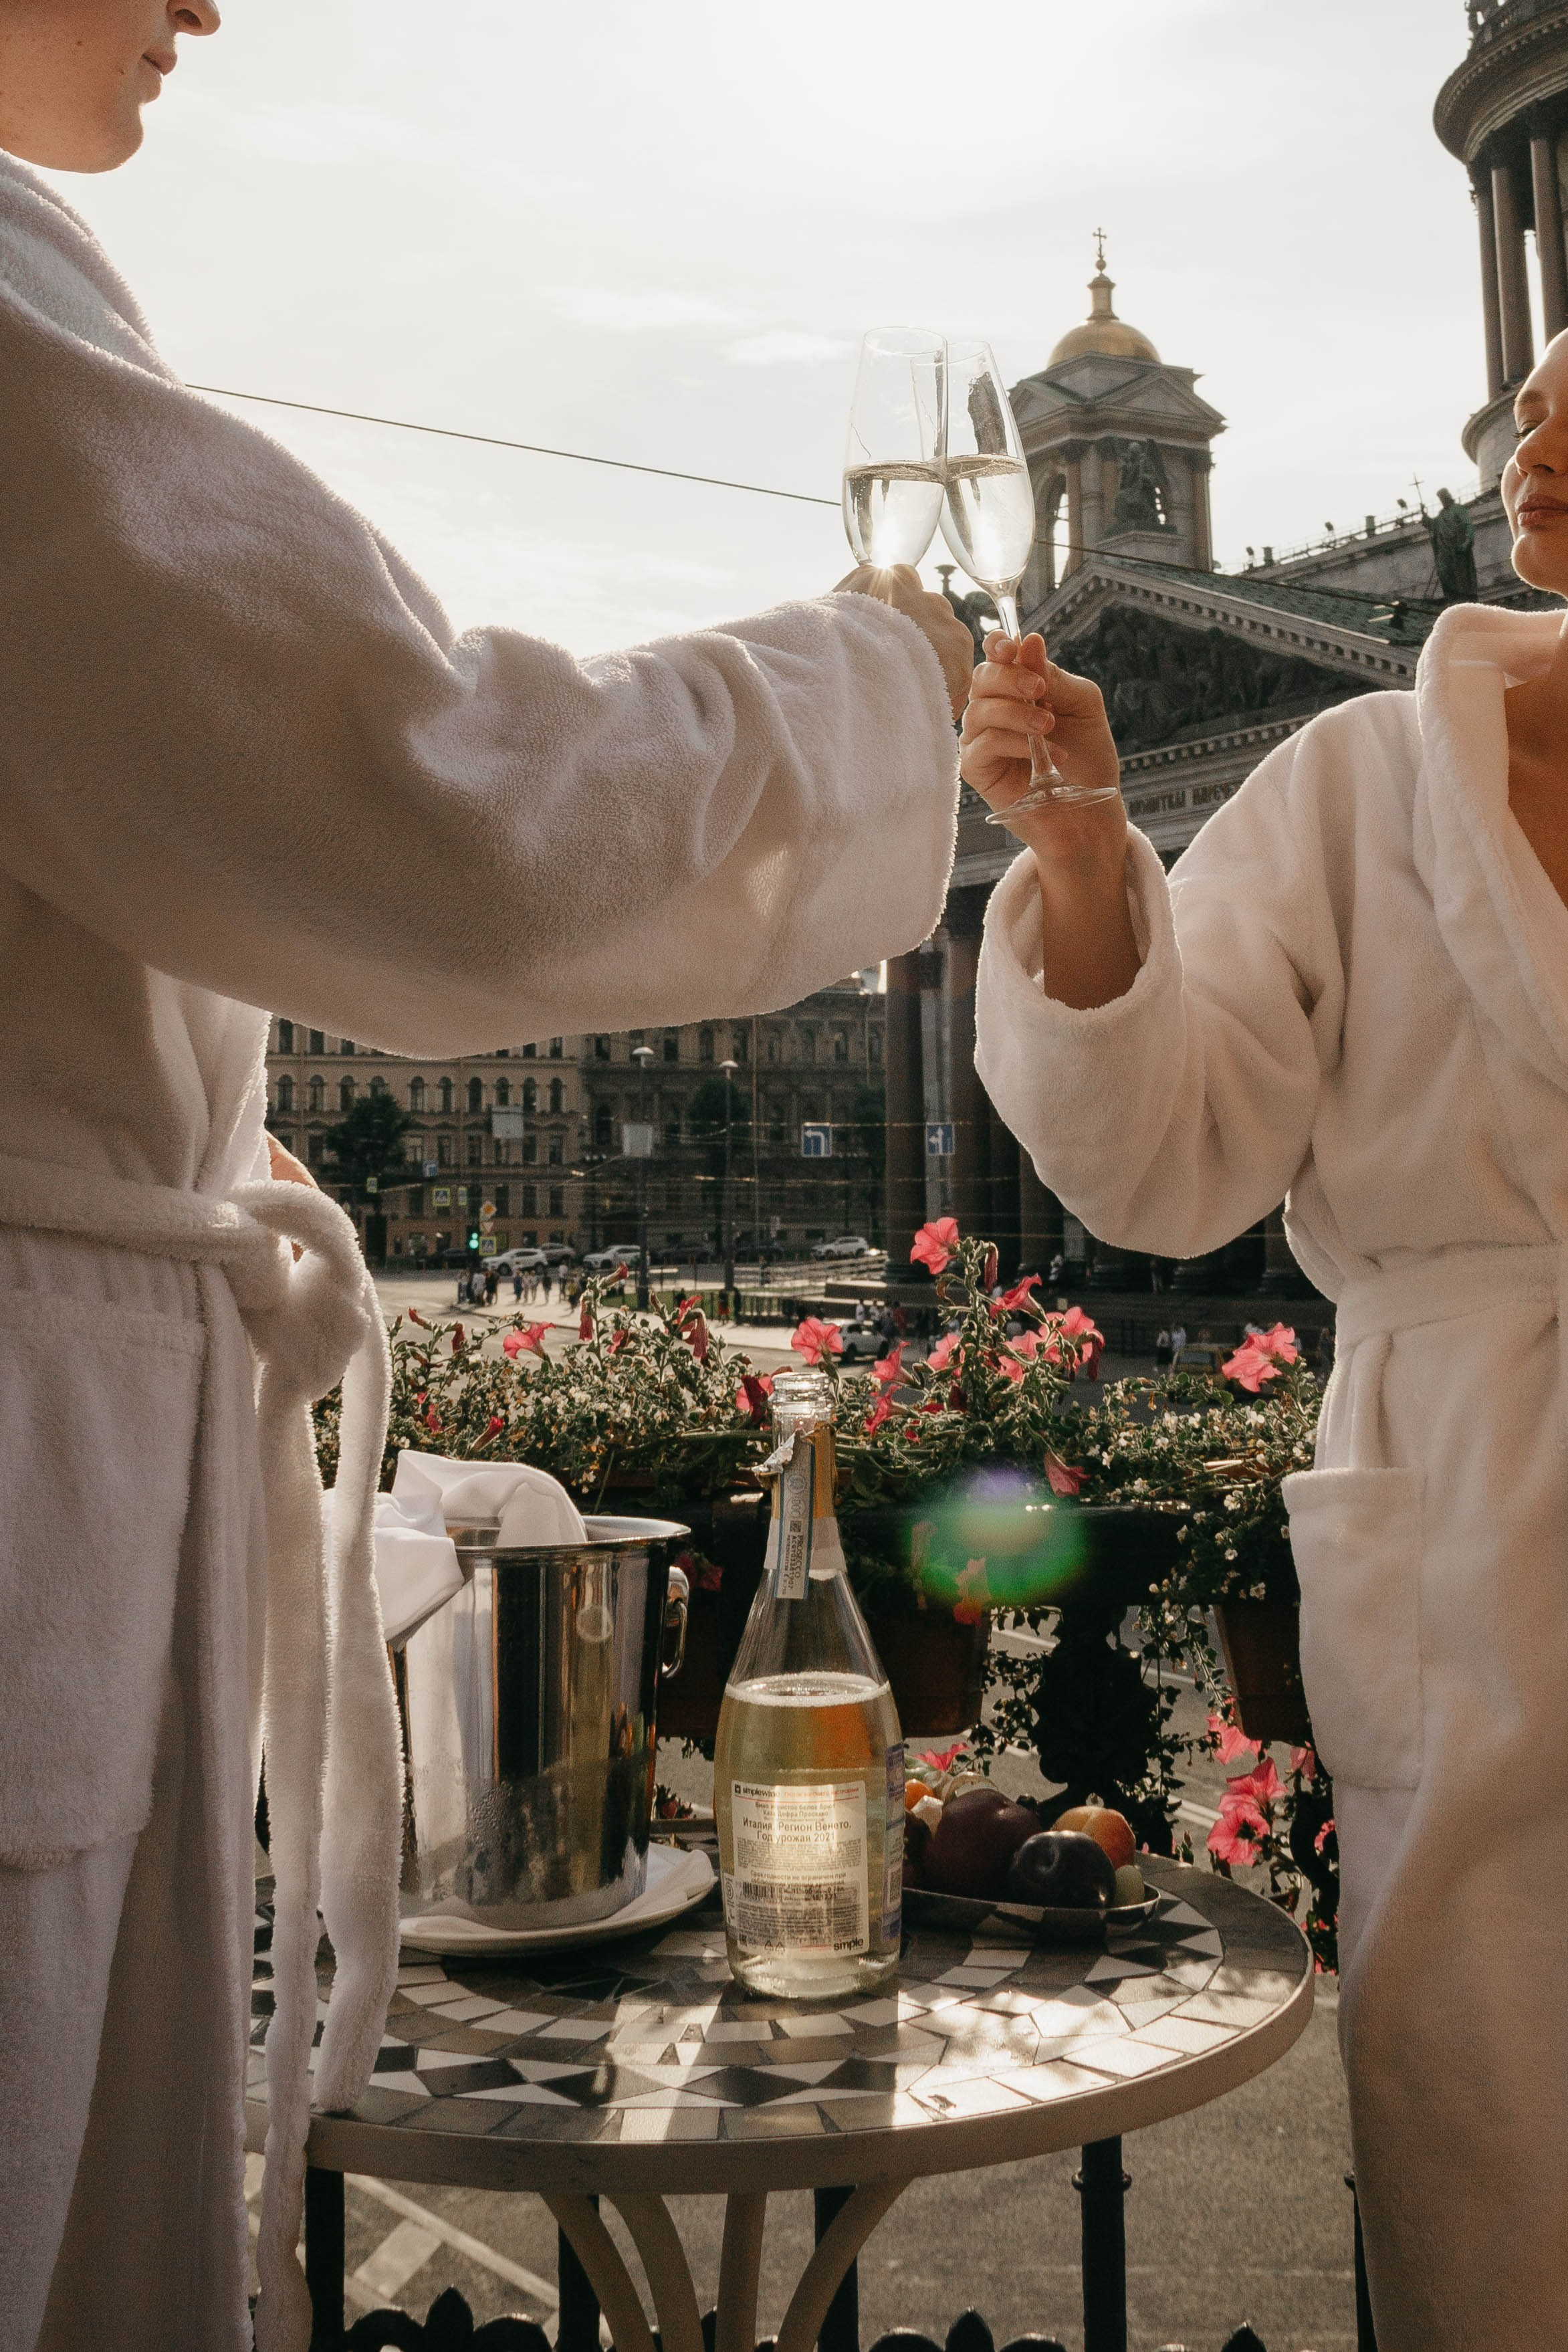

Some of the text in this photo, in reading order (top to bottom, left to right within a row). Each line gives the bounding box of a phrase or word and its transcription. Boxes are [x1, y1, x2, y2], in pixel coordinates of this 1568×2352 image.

[794, 1535, 804, 1578] PROSECCO
[778, 1822, 812, 1832] Регион
[815, 1820, 852, 1830] Венето.
[757, 1831, 835, 1844] Год урожая 2021
[833, 1937, 864, 1951] simple
